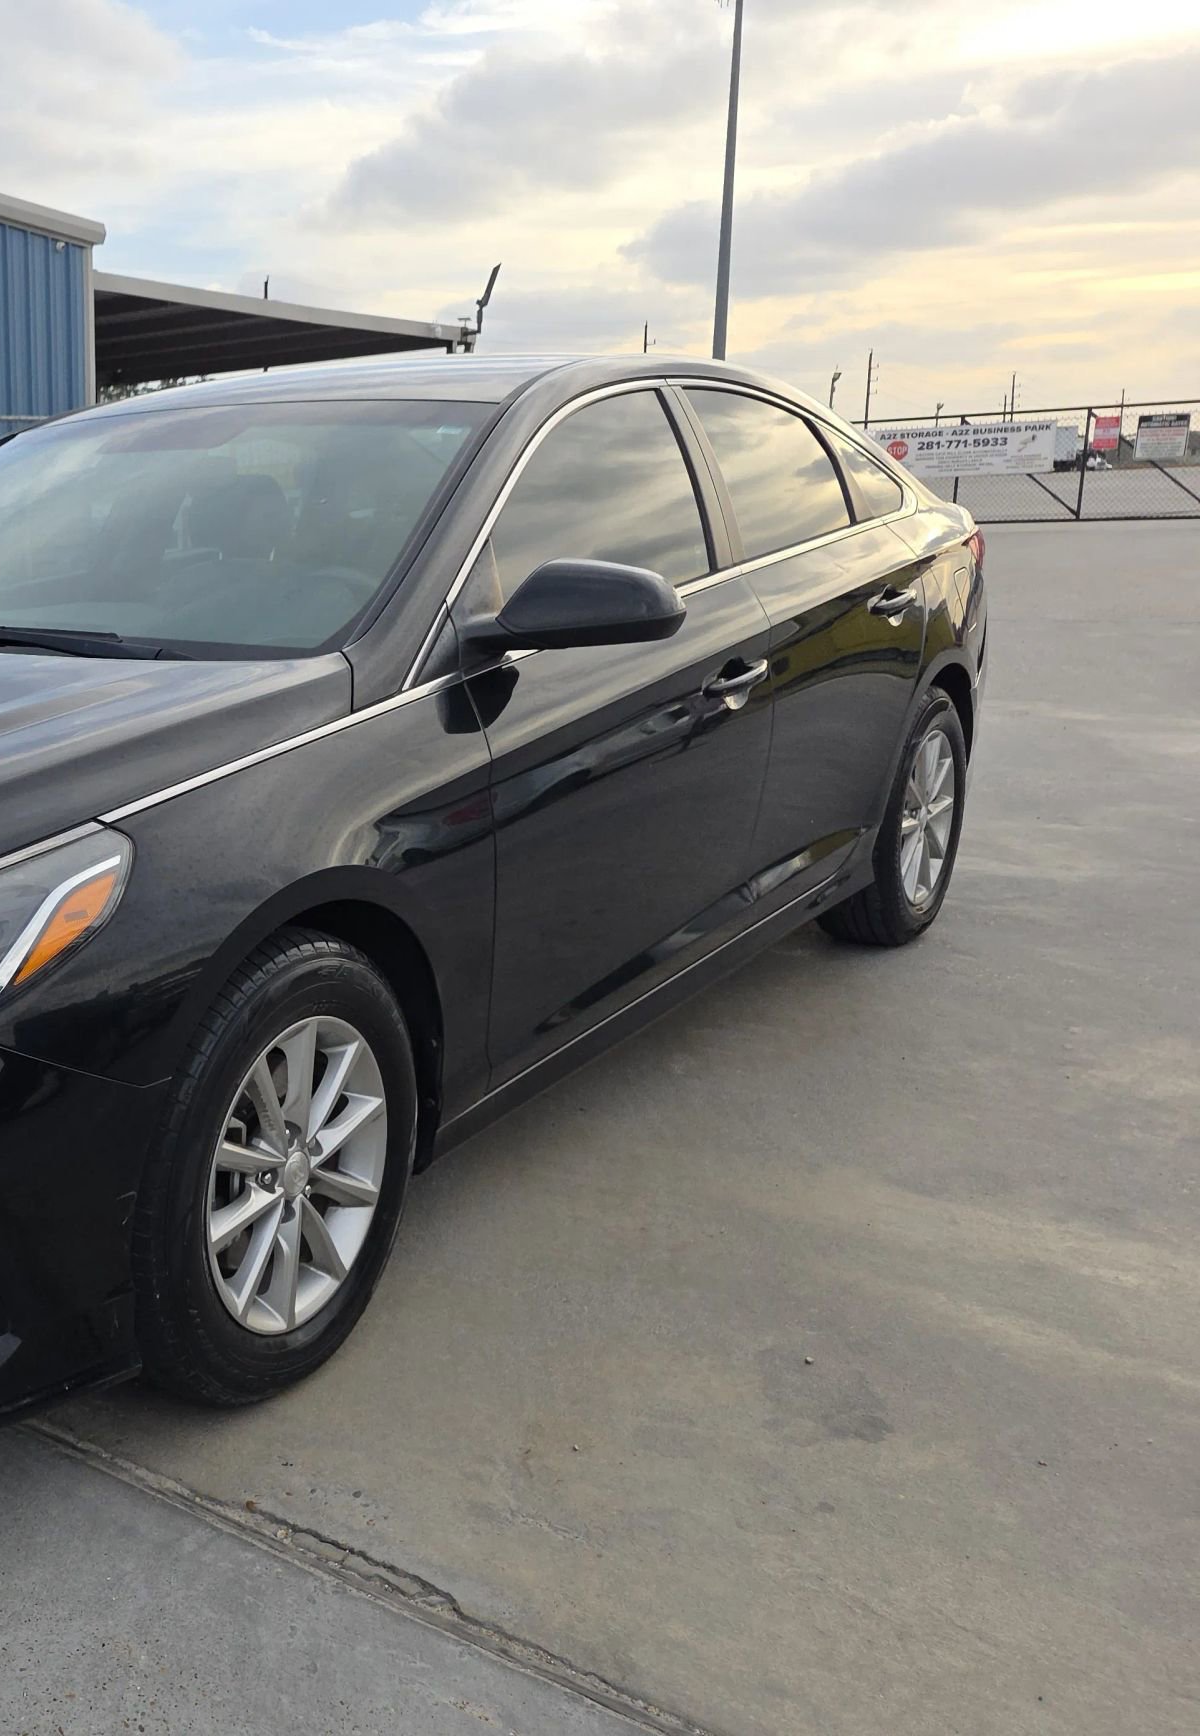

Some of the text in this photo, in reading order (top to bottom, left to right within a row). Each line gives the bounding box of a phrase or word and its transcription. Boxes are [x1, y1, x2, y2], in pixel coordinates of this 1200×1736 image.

[900, 431, 944, 440] STORAGE
[973, 426, 1022, 435] BUSINESS
[1025, 423, 1052, 432] PARK
[888, 446, 908, 455] STOP
[917, 437, 1008, 451] 281-771-5933
